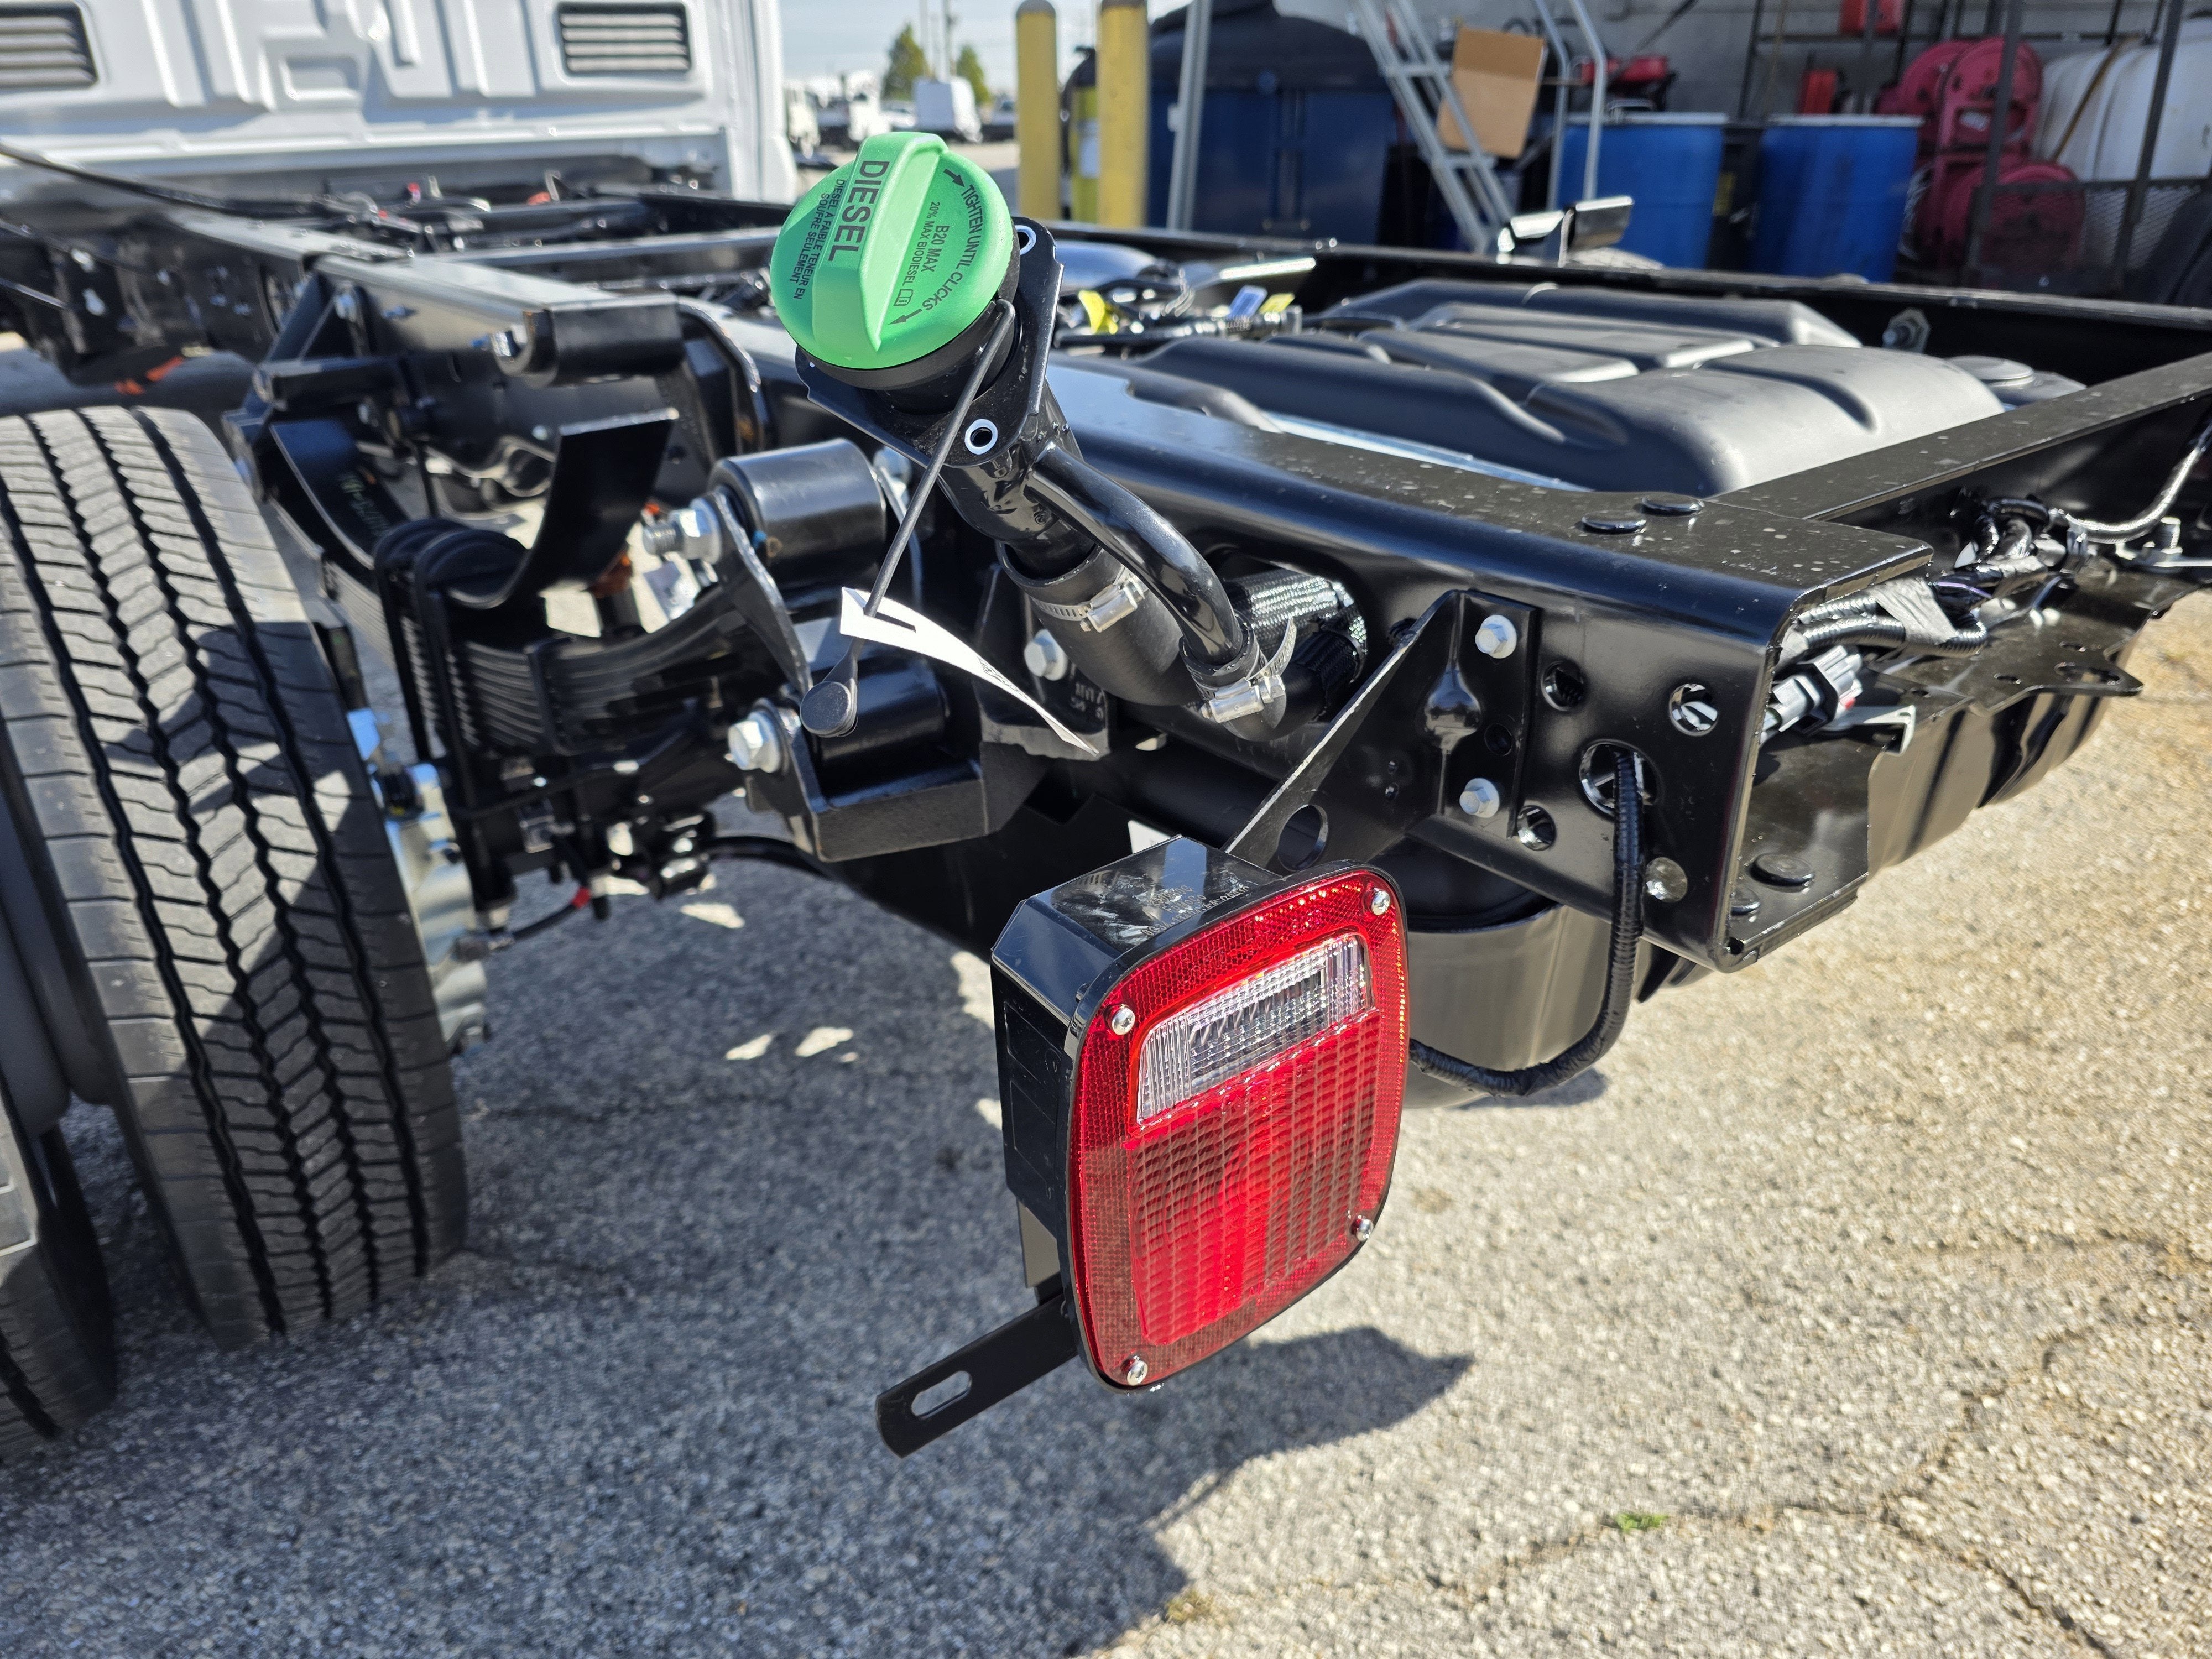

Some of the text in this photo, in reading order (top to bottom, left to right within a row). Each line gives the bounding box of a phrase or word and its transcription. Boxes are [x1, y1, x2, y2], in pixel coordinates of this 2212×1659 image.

[828, 161, 890, 262] DIESEL
[830, 179, 846, 210] DIESEL
[790, 193, 830, 283] SOUFRE SEULEMENT
[813, 221, 832, 250] FAIBLE
[902, 201, 940, 286] 20% MAX BIODIESEL
[921, 225, 950, 272] B20 MAX
[922, 184, 983, 311] TIGHTEN UNTIL CLICKS
[799, 252, 820, 286] TENEUR
[793, 288, 805, 299] EN
